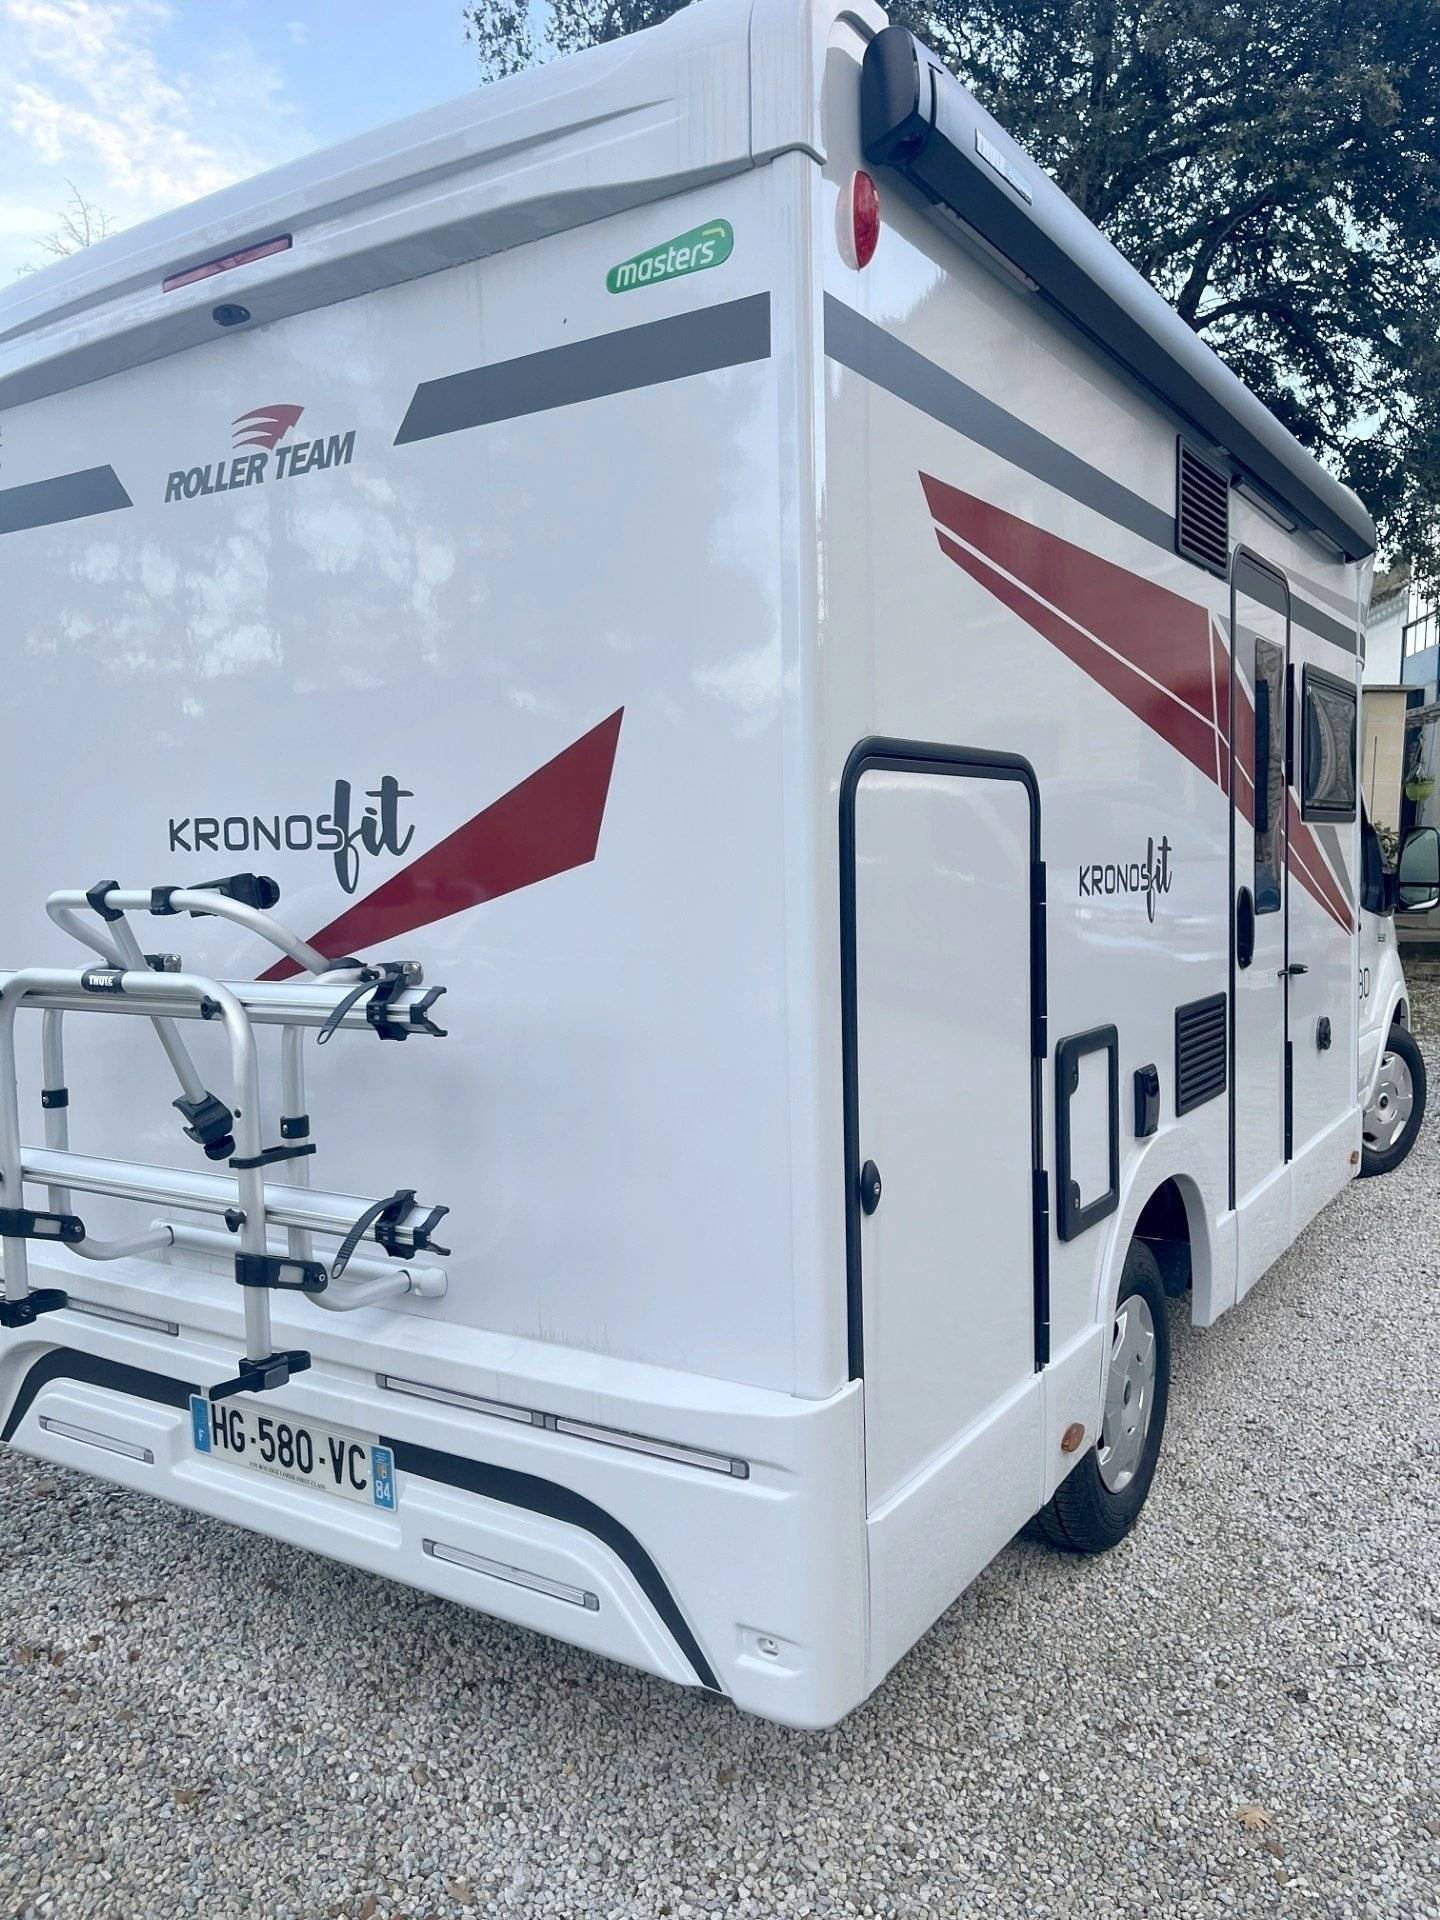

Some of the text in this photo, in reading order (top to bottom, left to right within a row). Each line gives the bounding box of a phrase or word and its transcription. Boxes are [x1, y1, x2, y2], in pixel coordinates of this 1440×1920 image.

[615, 239, 716, 288] masters
[164, 430, 356, 503] ROLLER TEAM
[88, 974, 114, 987] THULE
[198, 1429, 204, 1442] F
[211, 1403, 368, 1491] HG-580-VC
[375, 1480, 391, 1501] 84
